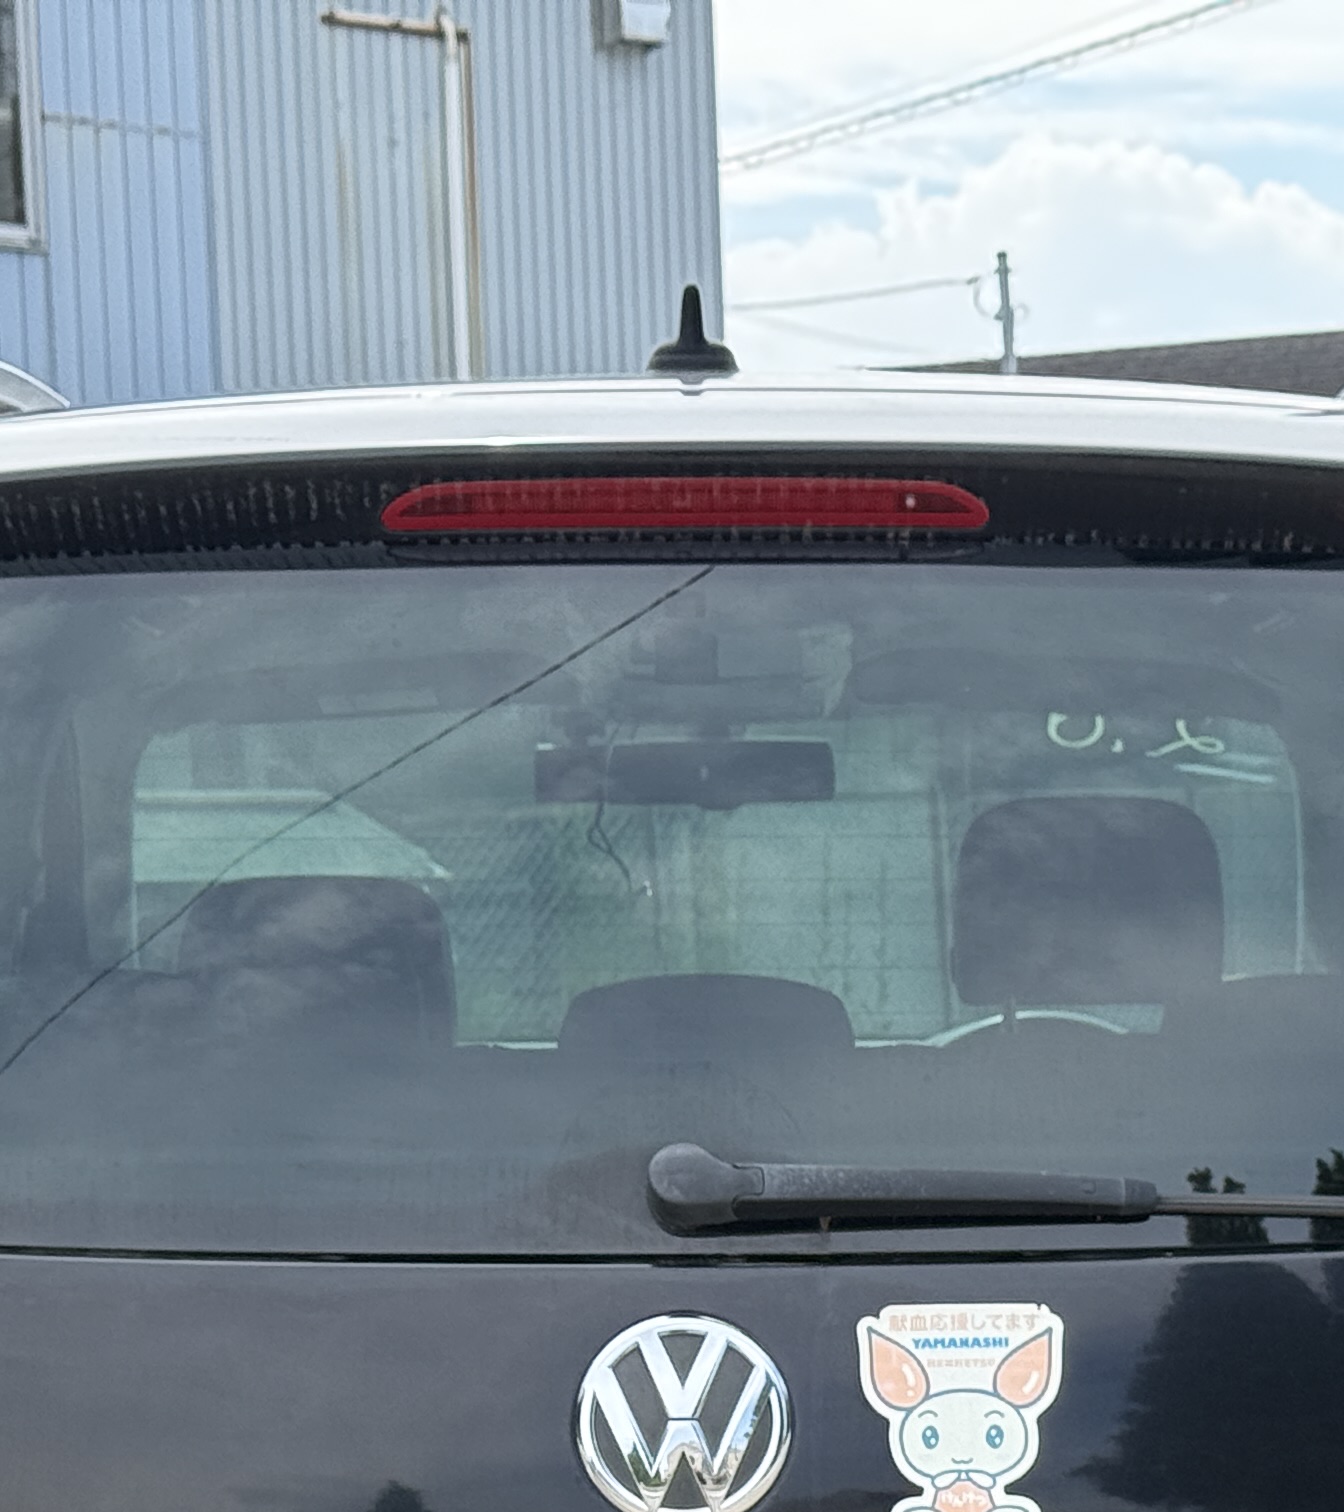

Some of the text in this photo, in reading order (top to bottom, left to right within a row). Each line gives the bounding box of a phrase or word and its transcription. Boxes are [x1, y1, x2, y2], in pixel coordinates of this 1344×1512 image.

[888, 1312, 1041, 1333] 献血応援してます
[912, 1336, 1010, 1350] YAMANASHI
